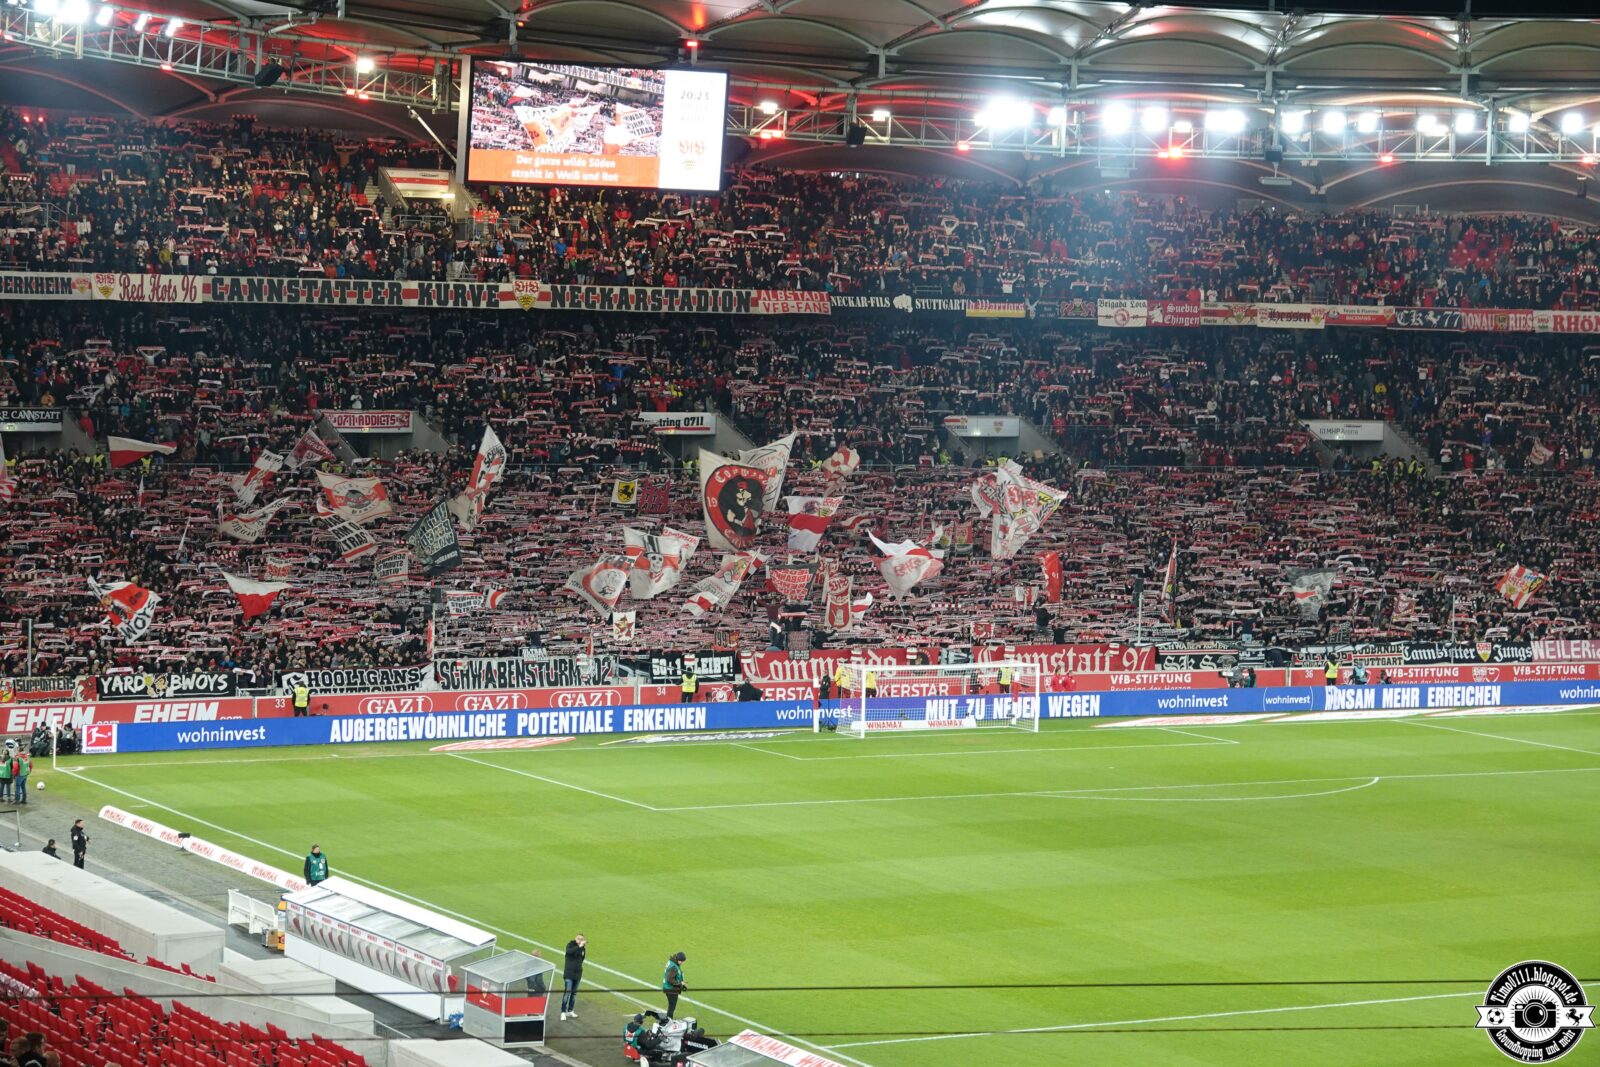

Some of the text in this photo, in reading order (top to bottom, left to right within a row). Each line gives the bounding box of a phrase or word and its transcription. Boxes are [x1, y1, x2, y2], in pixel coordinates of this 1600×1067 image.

[516, 155, 616, 168] Der ganze wilde Süden
[512, 168, 619, 182] strahlt in Weiß und Rot
[118, 274, 198, 302] Red Hots 96
[211, 277, 500, 307] CANNSTATTER KURVE
[760, 290, 829, 301] ALBSTADT
[551, 285, 751, 312] NECKARSTADION
[830, 295, 966, 311] NECKAR-FILS STUTTGART
[977, 299, 1024, 312] Warriors
[763, 302, 830, 313] VFB-FANS
[1443, 311, 1461, 327] 77
[1462, 313, 1533, 331] DONAU RIES
[11, 409, 60, 420] CANNSTATT
[337, 414, 396, 426] 0711 ADDICTS
[684, 416, 704, 426] 0711
[1122, 647, 1150, 672] 97
[1493, 644, 1533, 662] Jungs
[652, 656, 734, 676] 50+1 LEIBT!
[743, 650, 897, 682] Commdo
[1386, 667, 1459, 678] VfB-STIFTUNG
[1513, 665, 1586, 675] VfB-STIFTUNG
[100, 673, 228, 694] YARD BWOYS
[306, 667, 420, 688] HOOLIGANS
[1110, 673, 1192, 685] VfB-STIFTUNG
[656, 686, 666, 696] 34
[1265, 694, 1310, 704] wohninvest
[1382, 687, 1420, 709] MEHR
[1428, 685, 1501, 708] ERREICHEN
[274, 698, 286, 708] 33
[926, 699, 958, 720] MUT
[968, 698, 986, 720] ZU
[1048, 695, 1100, 718] WEGEN
[1158, 694, 1228, 709] wohninvest
[6, 706, 96, 733] EHEIM
[134, 702, 219, 724] EHEIM
[776, 705, 852, 720] wohnnvest
[517, 709, 614, 736] POTENTIALE
[624, 707, 706, 732] ERKENNEN
[866, 722, 903, 730] WINAMAX
[177, 726, 266, 744] wohninvest
